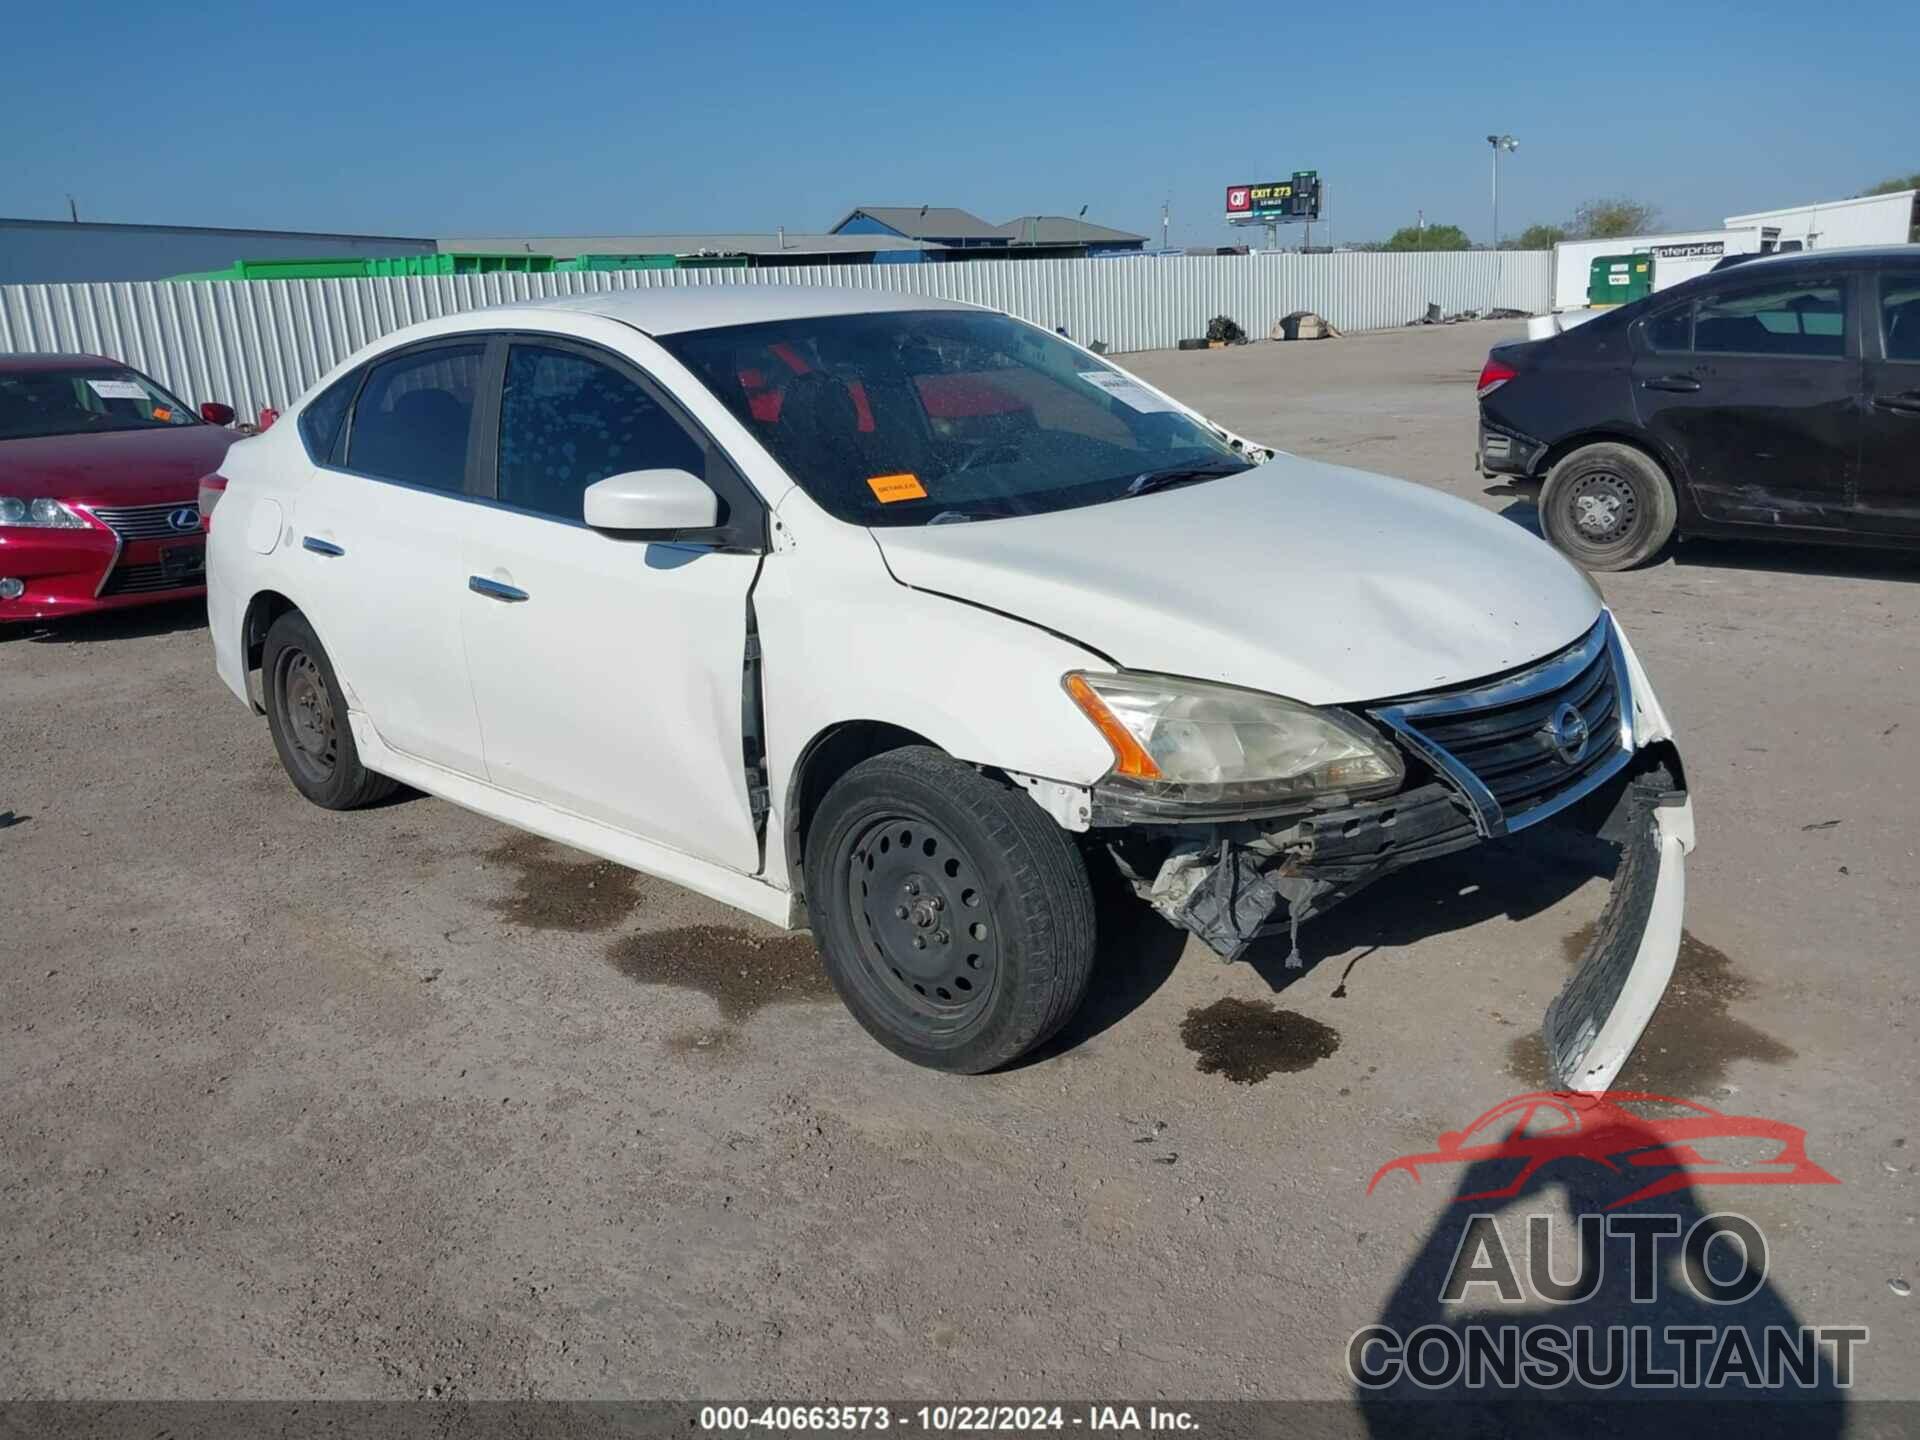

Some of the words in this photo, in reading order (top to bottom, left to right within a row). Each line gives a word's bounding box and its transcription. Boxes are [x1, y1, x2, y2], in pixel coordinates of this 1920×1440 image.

[1231, 191, 1246, 206] QT
[1251, 189, 1271, 199] EXIT
[1273, 186, 1292, 197] 273
[1652, 244, 1723, 257] Enterprise
